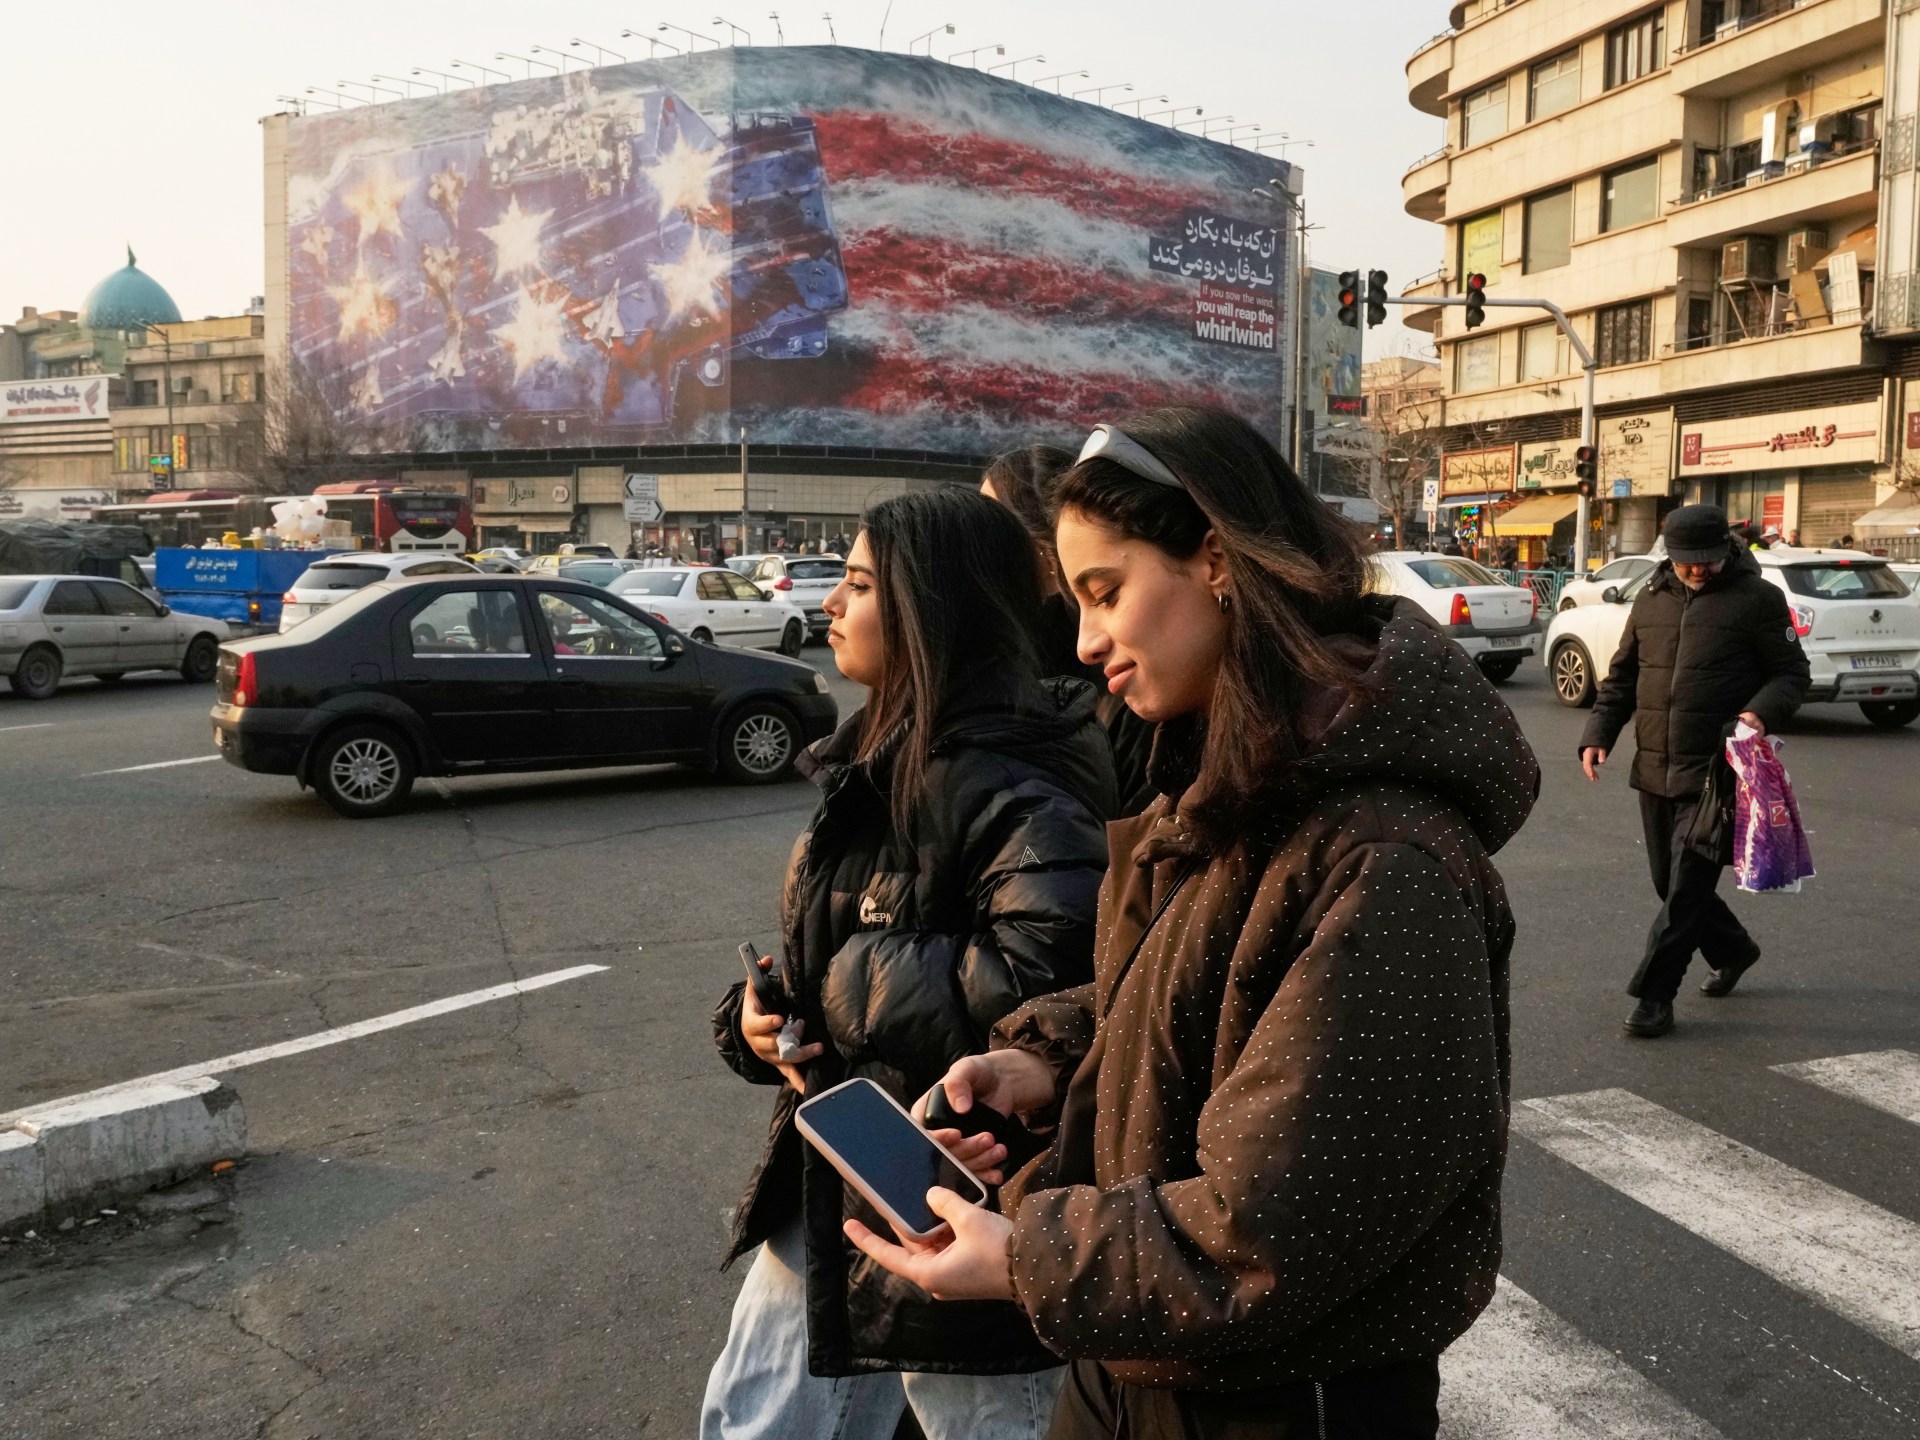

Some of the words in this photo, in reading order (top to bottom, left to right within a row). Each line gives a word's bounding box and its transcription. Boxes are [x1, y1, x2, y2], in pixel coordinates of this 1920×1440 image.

[1185, 216, 1219, 247] بکارد
[1222, 223, 1243, 253] باد
[1225, 257, 1274, 289] طوفان
[1202, 285, 1209, 295] If
[1210, 288, 1224, 298] you
[1225, 290, 1241, 301] sow
[1242, 293, 1255, 304] the
[1196, 300, 1216, 314] you
[1216, 302, 1234, 317] will
[1235, 308, 1257, 324] reap
[1258, 309, 1274, 324] the
[1196, 317, 1273, 349] whirlwind
